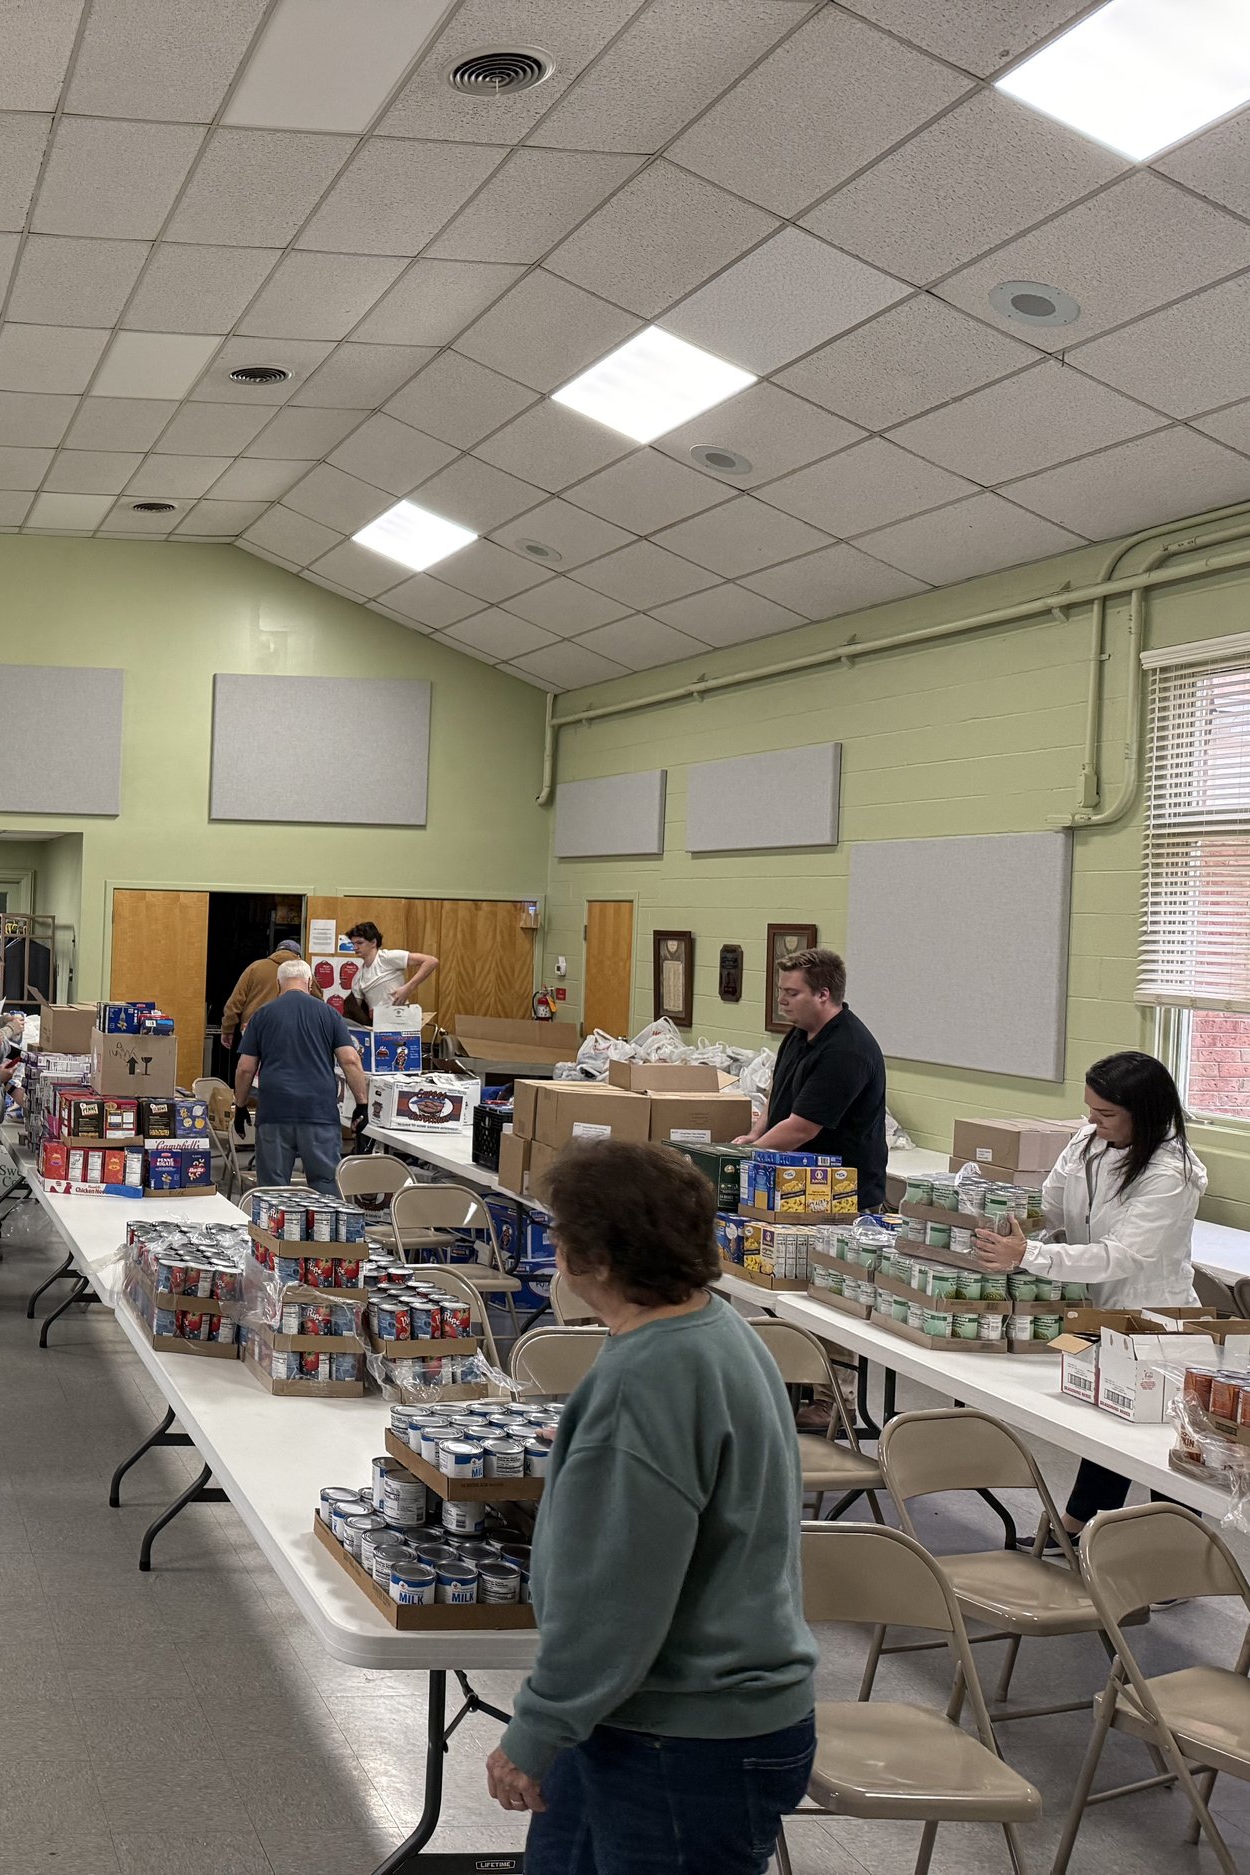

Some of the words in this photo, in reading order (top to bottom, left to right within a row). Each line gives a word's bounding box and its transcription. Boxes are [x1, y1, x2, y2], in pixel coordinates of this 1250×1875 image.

[307, 1307, 323, 1322] Ripe
[444, 1310, 460, 1327] Ripe
[399, 1592, 424, 1605] MILK
[451, 1592, 474, 1604] MILK
